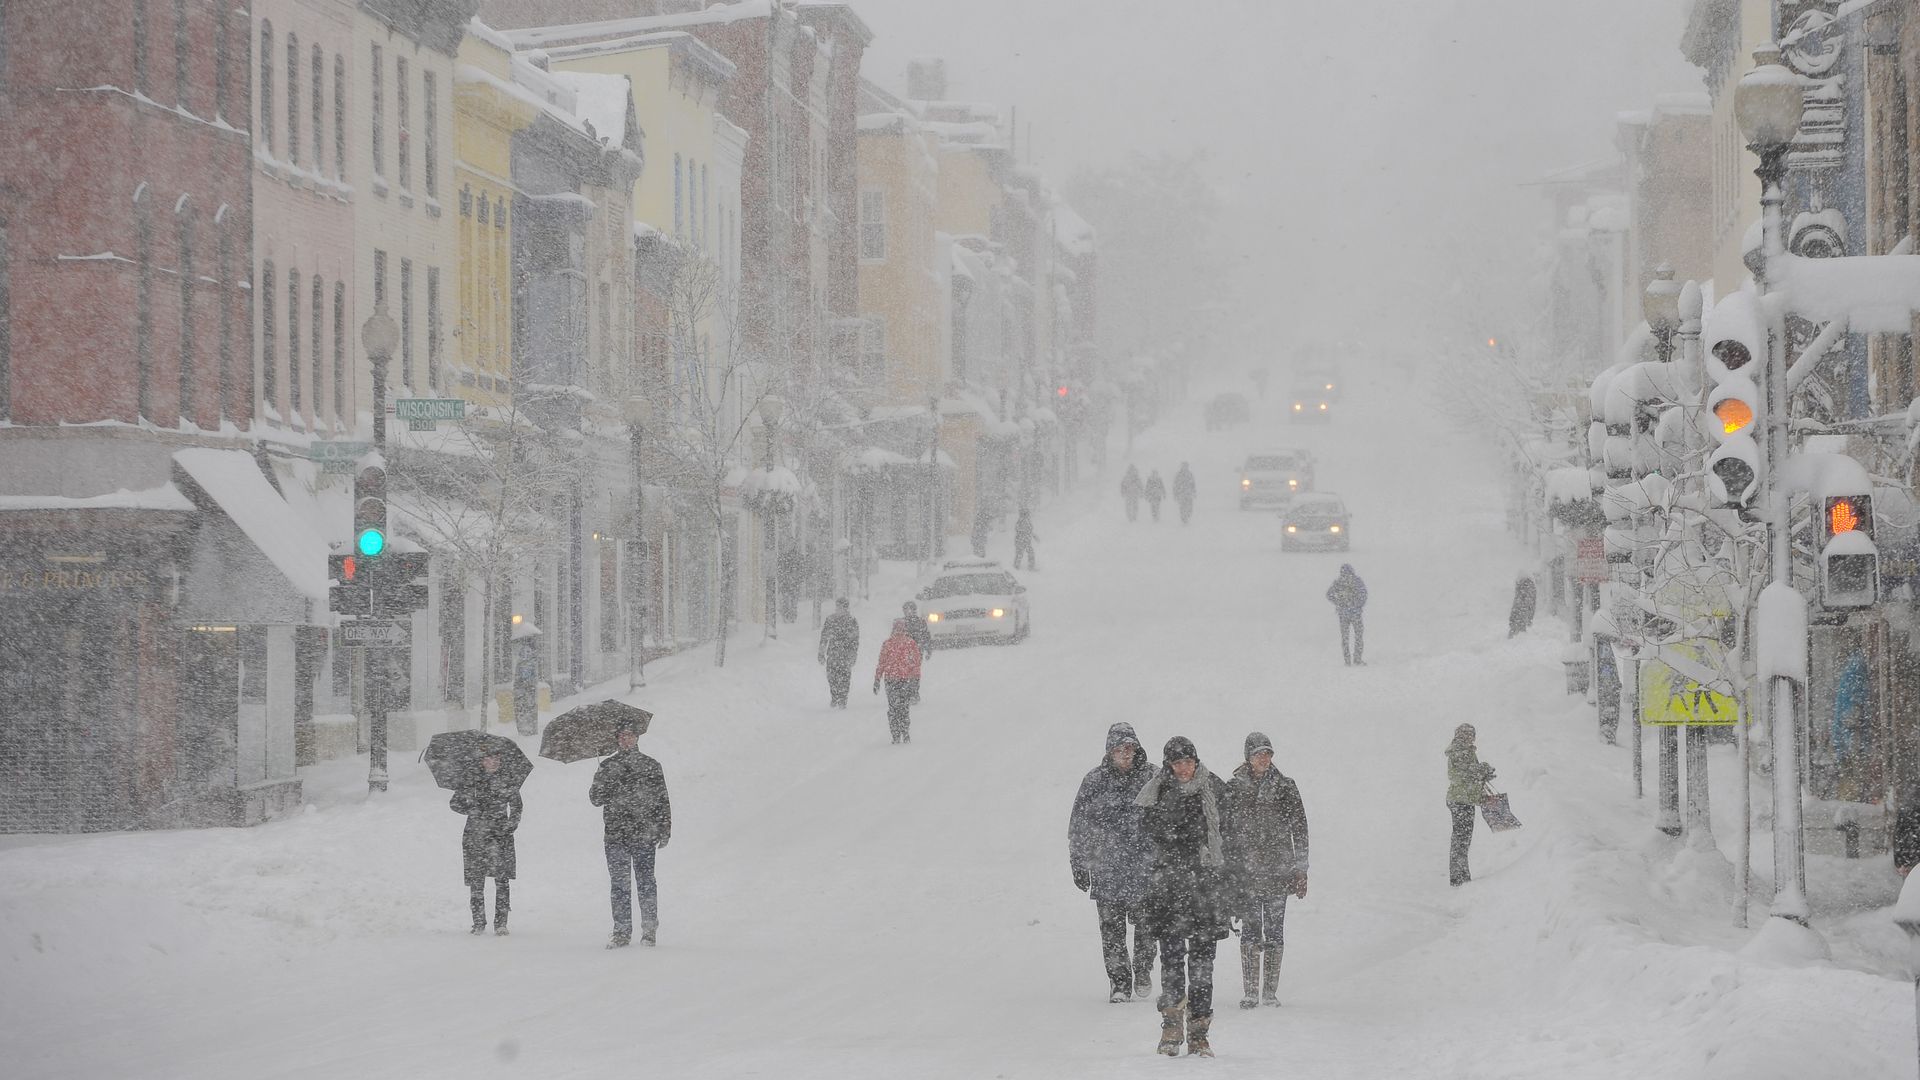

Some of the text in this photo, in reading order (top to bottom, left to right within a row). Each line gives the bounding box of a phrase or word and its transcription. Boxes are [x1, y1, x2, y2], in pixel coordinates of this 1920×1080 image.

[398, 401, 454, 417] WISCONSIN
[347, 628, 390, 639] ONE WAY
